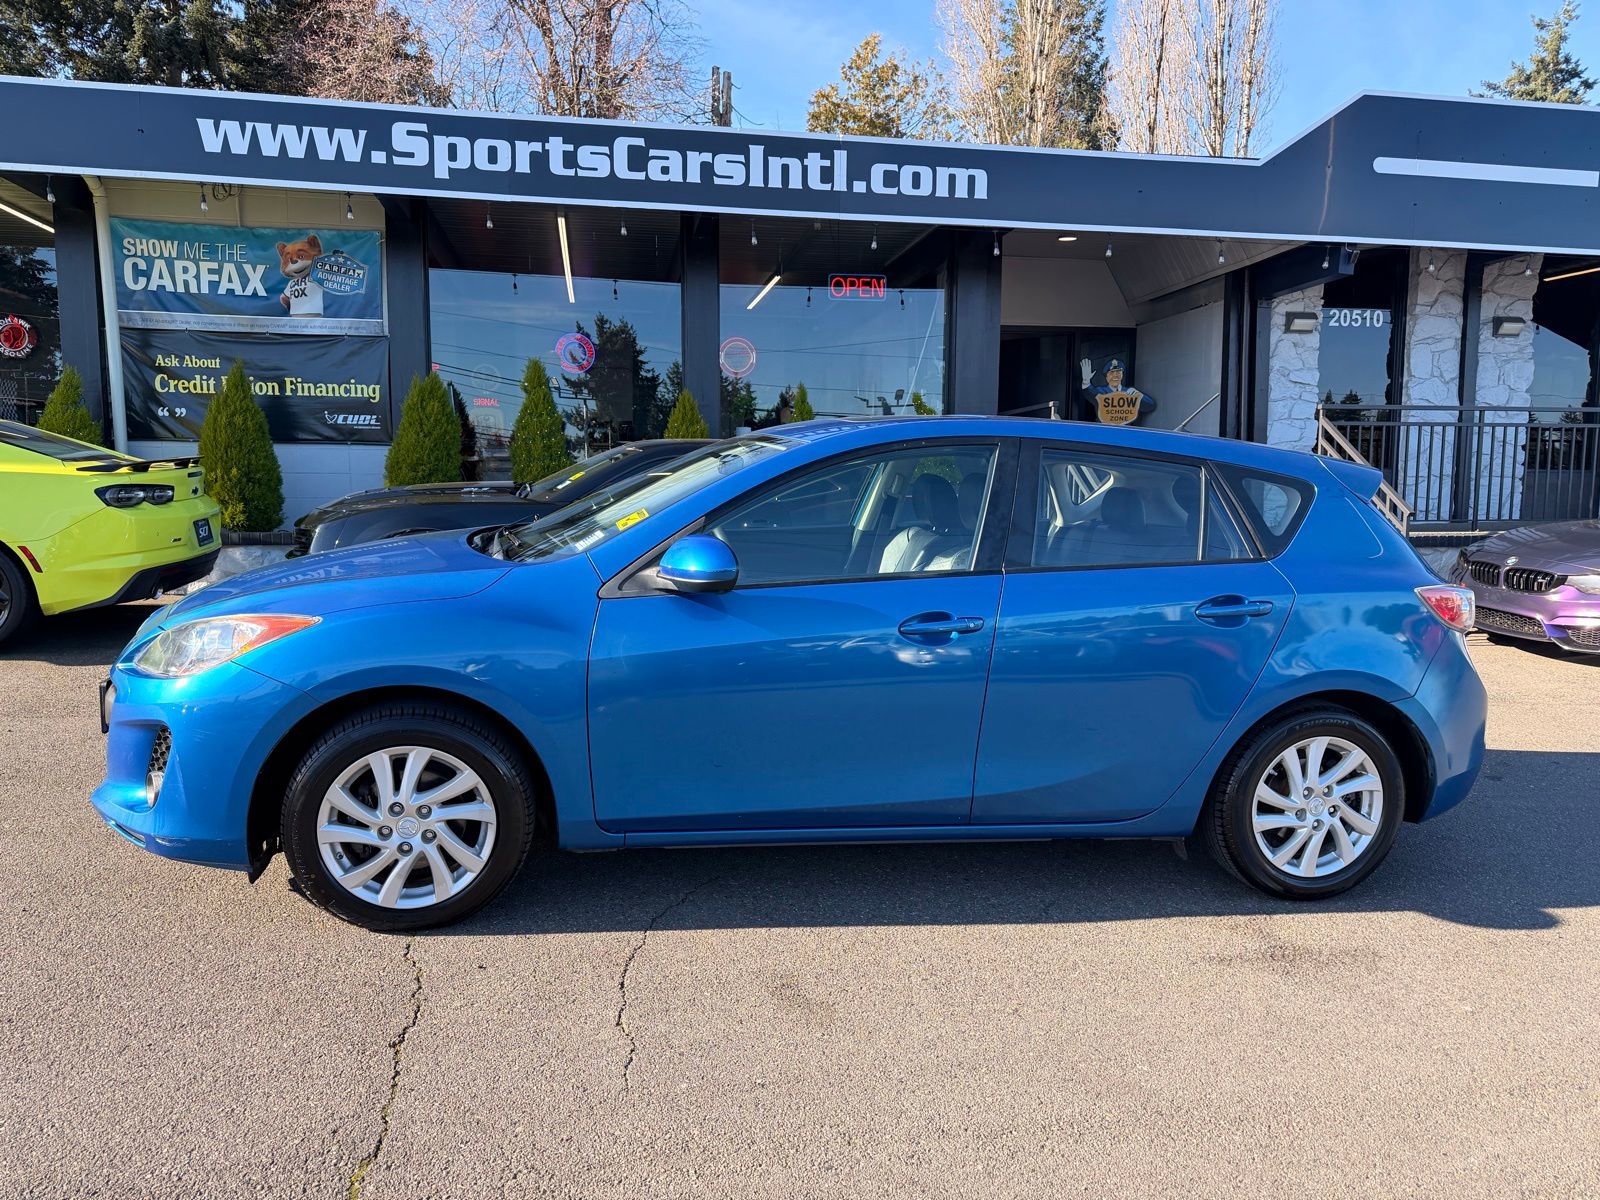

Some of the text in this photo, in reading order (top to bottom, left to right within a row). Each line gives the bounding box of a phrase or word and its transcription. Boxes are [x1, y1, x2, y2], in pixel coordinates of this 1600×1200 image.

[196, 118, 988, 200] www.SportsCarsIntl.com
[123, 238, 247, 262] SHOW ME THE
[124, 257, 267, 297] CARFAX
[316, 262, 363, 278] CARFAX
[317, 271, 359, 287] ADVANTAGE
[323, 280, 351, 292] DEALER
[831, 276, 885, 298] OPEN
[290, 287, 308, 299] FOX
[1329, 309, 1383, 328] 20510
[0, 343, 34, 357] ASOLINE
[155, 354, 220, 369] Ask About
[154, 374, 216, 395] Credit
[284, 377, 380, 402] Financing
[1103, 397, 1138, 409] SLOW
